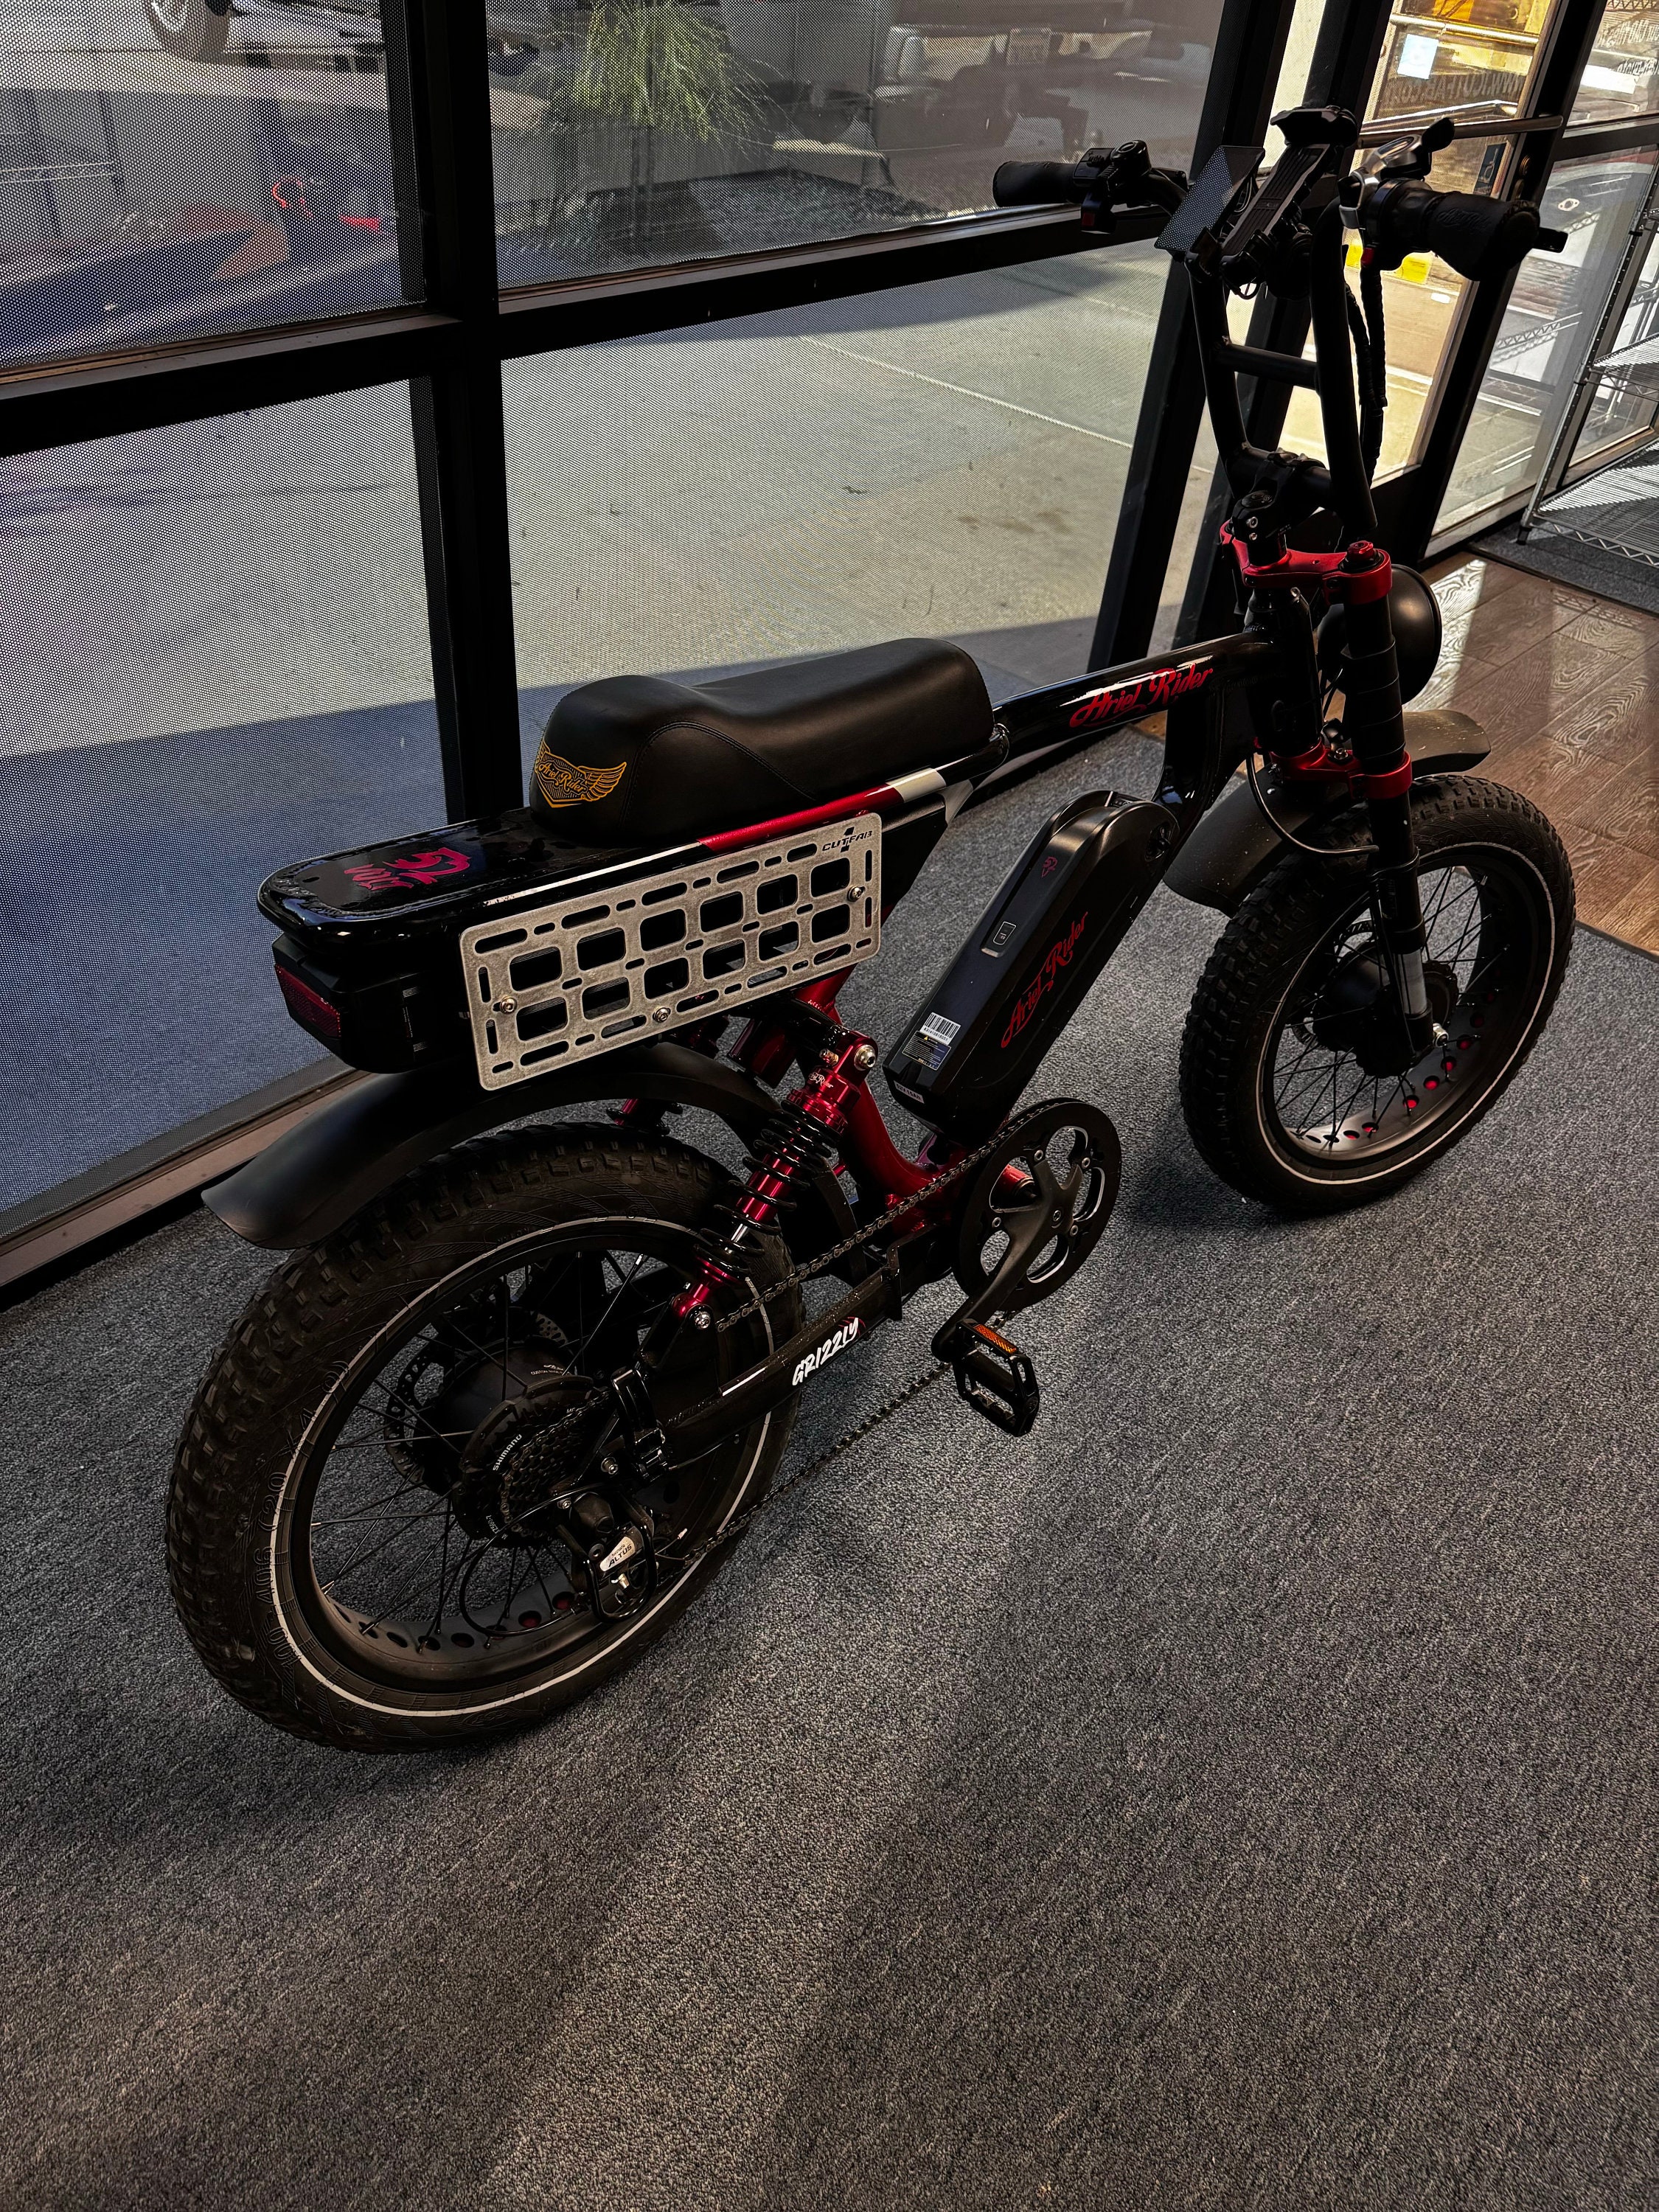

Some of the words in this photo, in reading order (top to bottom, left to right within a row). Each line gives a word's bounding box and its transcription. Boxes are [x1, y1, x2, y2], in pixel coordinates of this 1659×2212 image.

[1069, 684, 1147, 728] Ariel
[1148, 662, 1214, 706] Rider
[538, 762, 560, 786] Ariel
[558, 771, 587, 793] Rider
[821, 830, 873, 852] CUTFAB
[1001, 965, 1054, 1049] Ariel
[1046, 911, 1089, 976] Rider
[492, 1433, 523, 1472] SHIMANO
[608, 1543, 632, 1568] ALTUS
